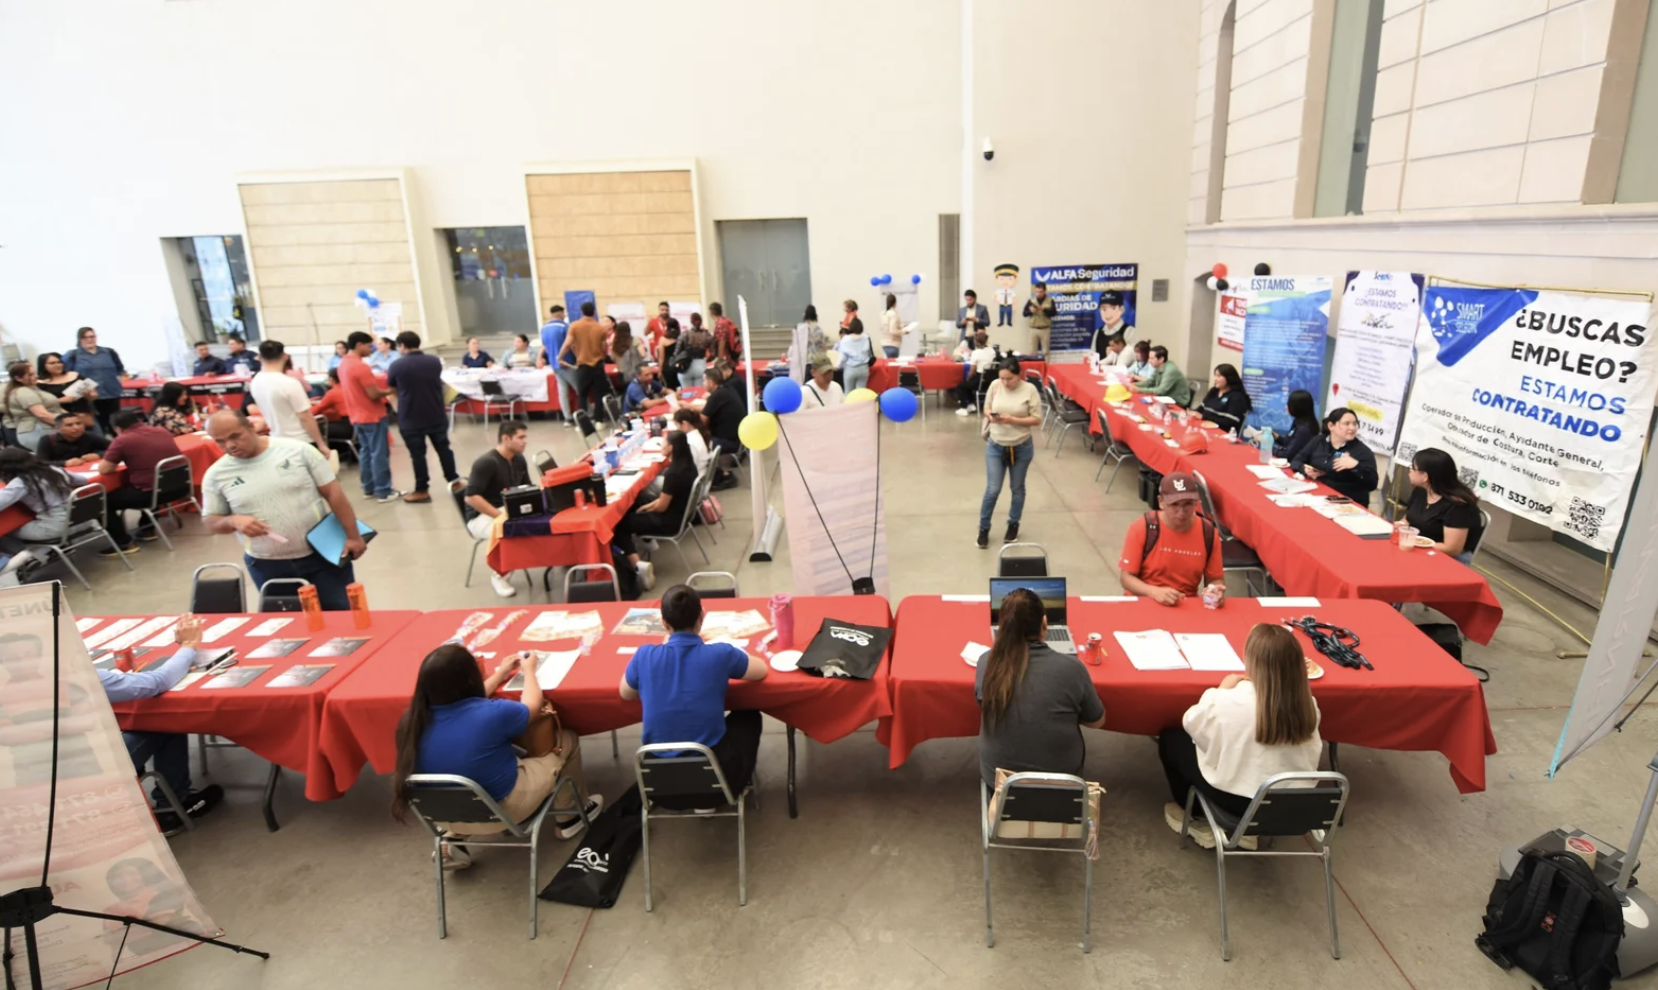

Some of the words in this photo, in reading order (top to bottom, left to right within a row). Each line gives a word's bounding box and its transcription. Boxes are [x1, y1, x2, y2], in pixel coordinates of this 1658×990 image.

[1050, 269, 1077, 280] ALFA
[1077, 266, 1134, 280] Seguridad
[1251, 279, 1295, 291] ESTAMOS
[1055, 301, 1098, 311] URIDAD
[1515, 308, 1647, 347] ¿BUSCAS
[1510, 340, 1638, 384] EMPLEO?
[1520, 375, 1627, 415] ESTAMOS
[1472, 388, 1622, 442] CONTRATANDO
[1476, 434, 1489, 445] de
[1527, 451, 1560, 468] Corte
[1509, 432, 1555, 454] Ayudante
[1557, 448, 1604, 472] General,
[1507, 490, 1527, 506] 533
